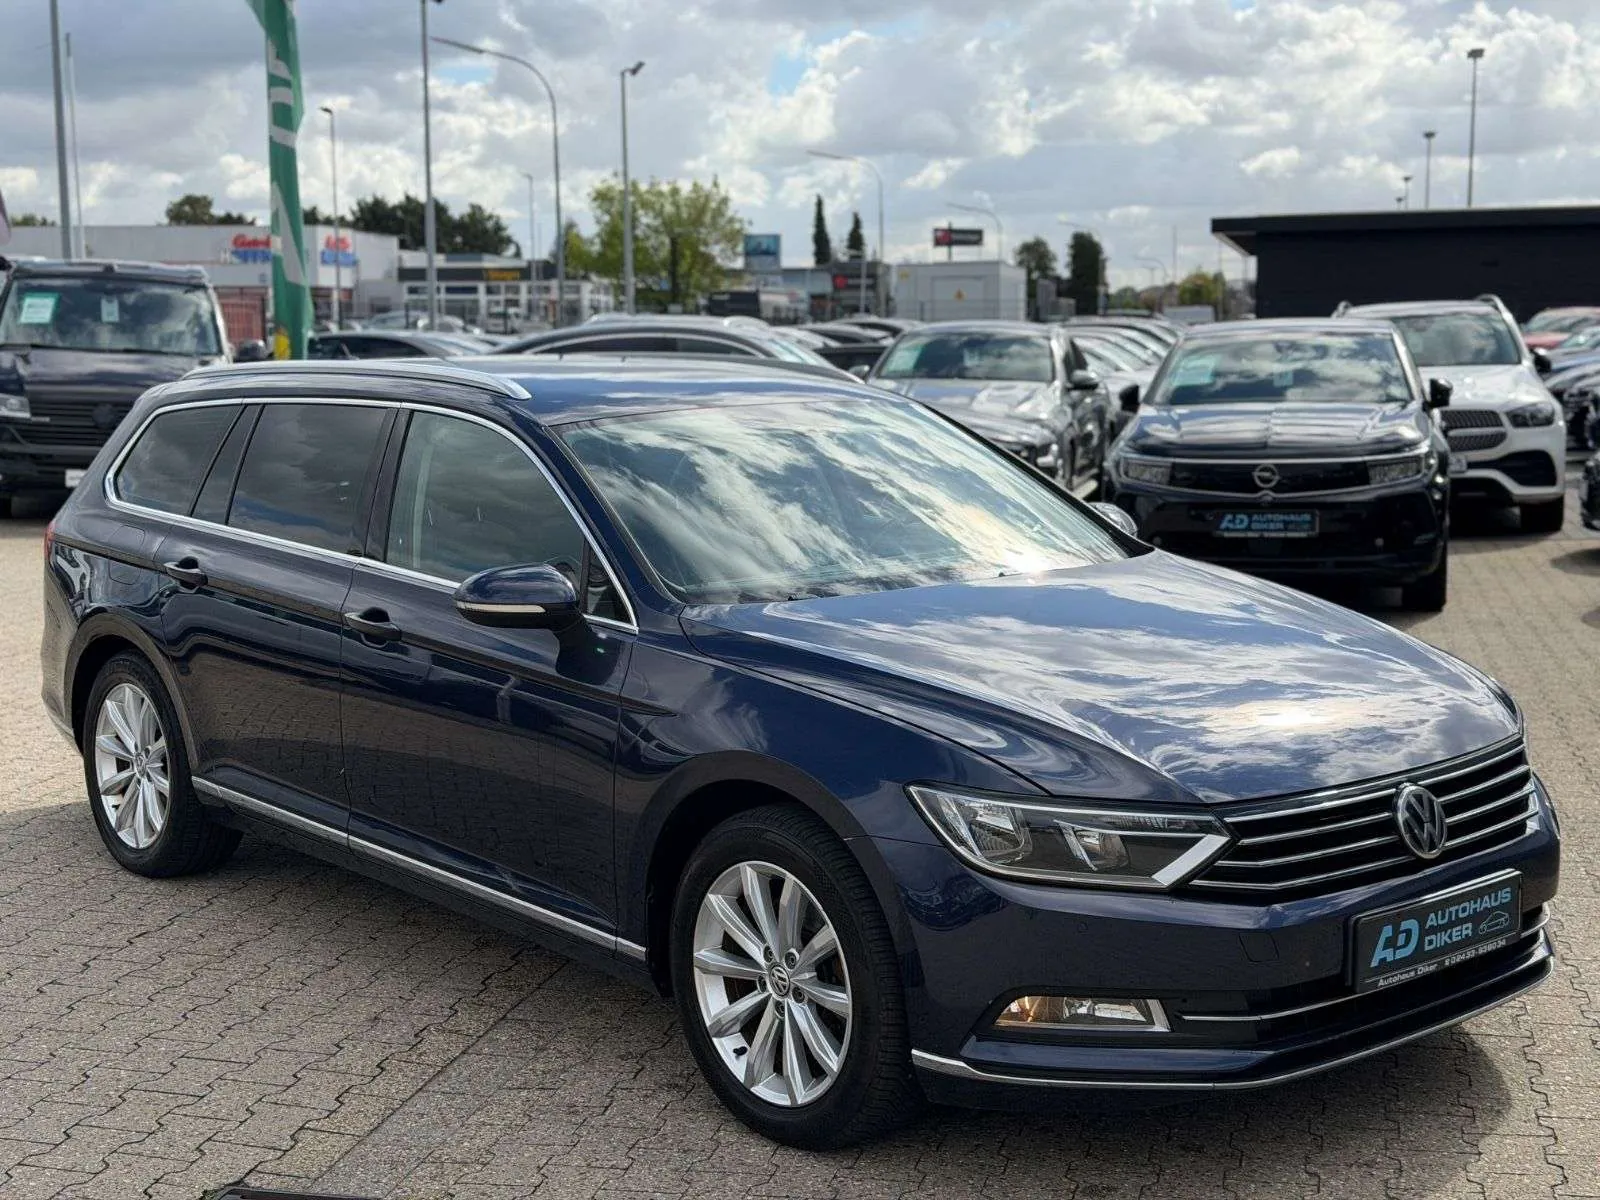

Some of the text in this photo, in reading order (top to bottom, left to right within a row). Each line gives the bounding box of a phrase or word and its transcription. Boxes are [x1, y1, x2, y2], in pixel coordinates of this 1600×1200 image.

[1424, 887, 1512, 930] AUTOHAUS
[1423, 922, 1474, 951] DIKER
[1377, 970, 1416, 987] Autohaus
[1417, 963, 1439, 975] Diker
